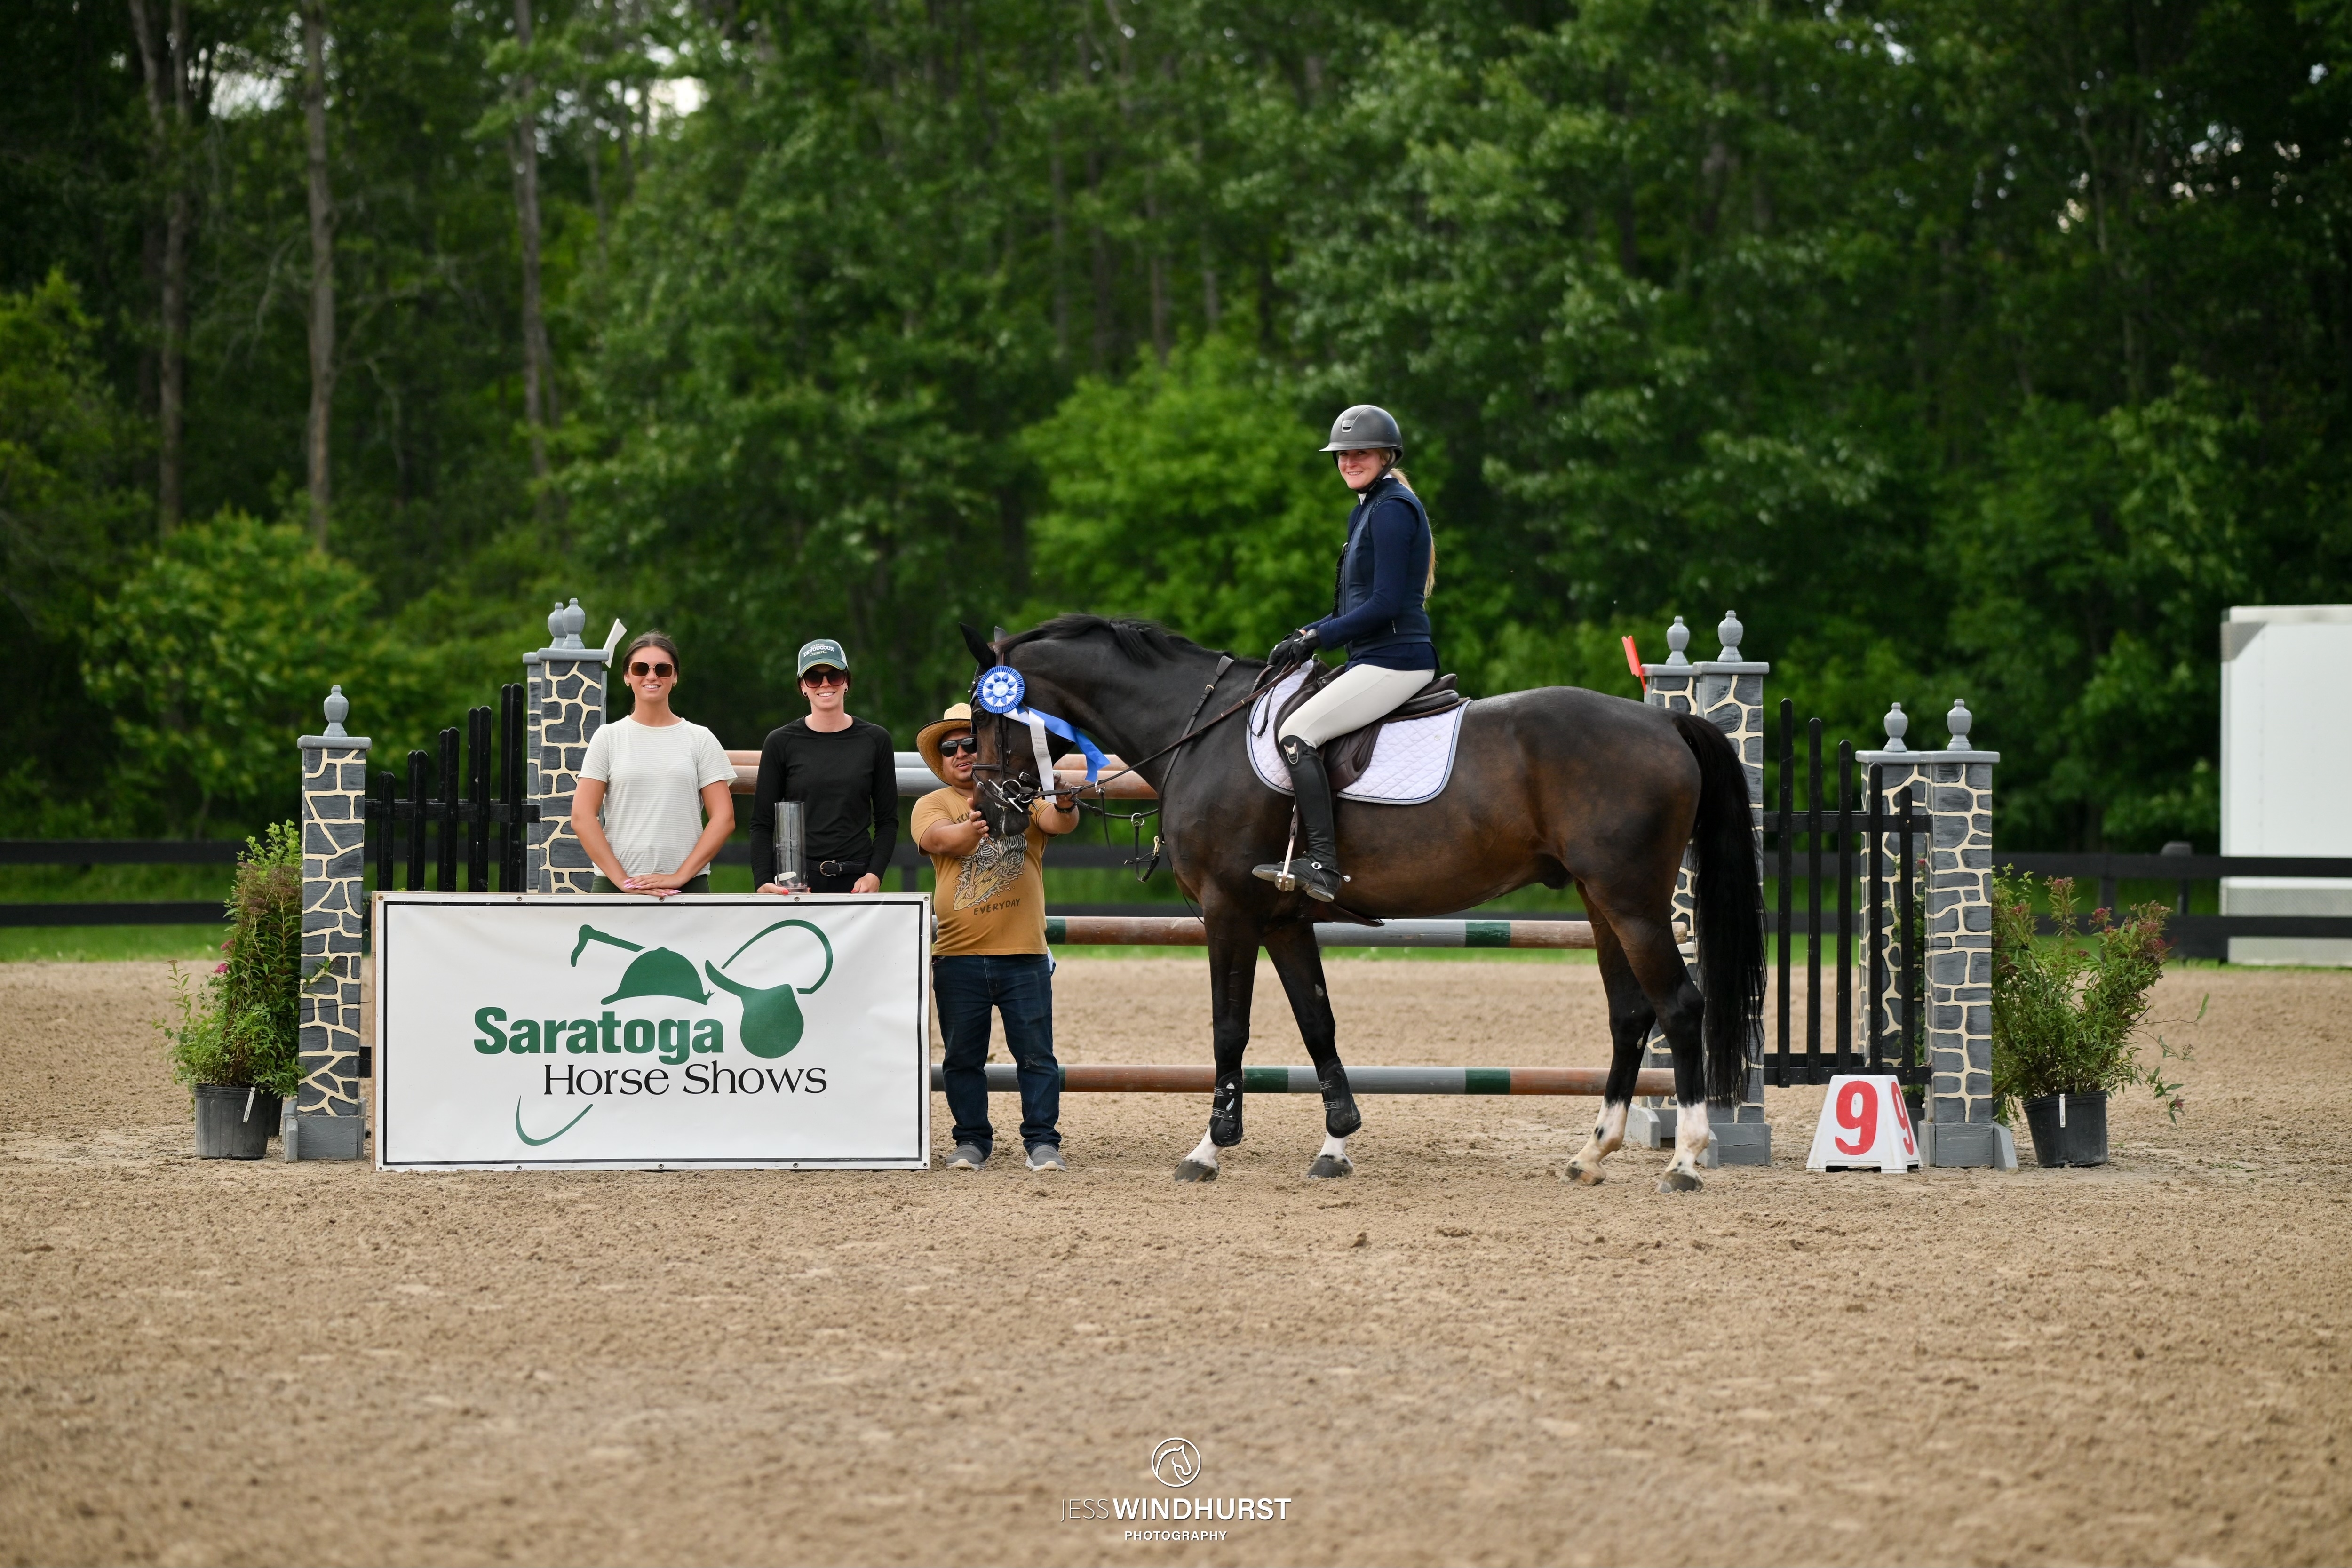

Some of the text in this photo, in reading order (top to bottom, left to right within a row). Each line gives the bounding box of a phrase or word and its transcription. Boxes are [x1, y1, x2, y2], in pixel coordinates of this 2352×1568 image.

[974, 898, 1020, 915] EVERYDAY
[474, 1007, 723, 1065] Saratoga
[544, 1061, 827, 1095] Horse Shows
[1836, 1081, 1878, 1155] 9
[1891, 1081, 1914, 1155] 9
